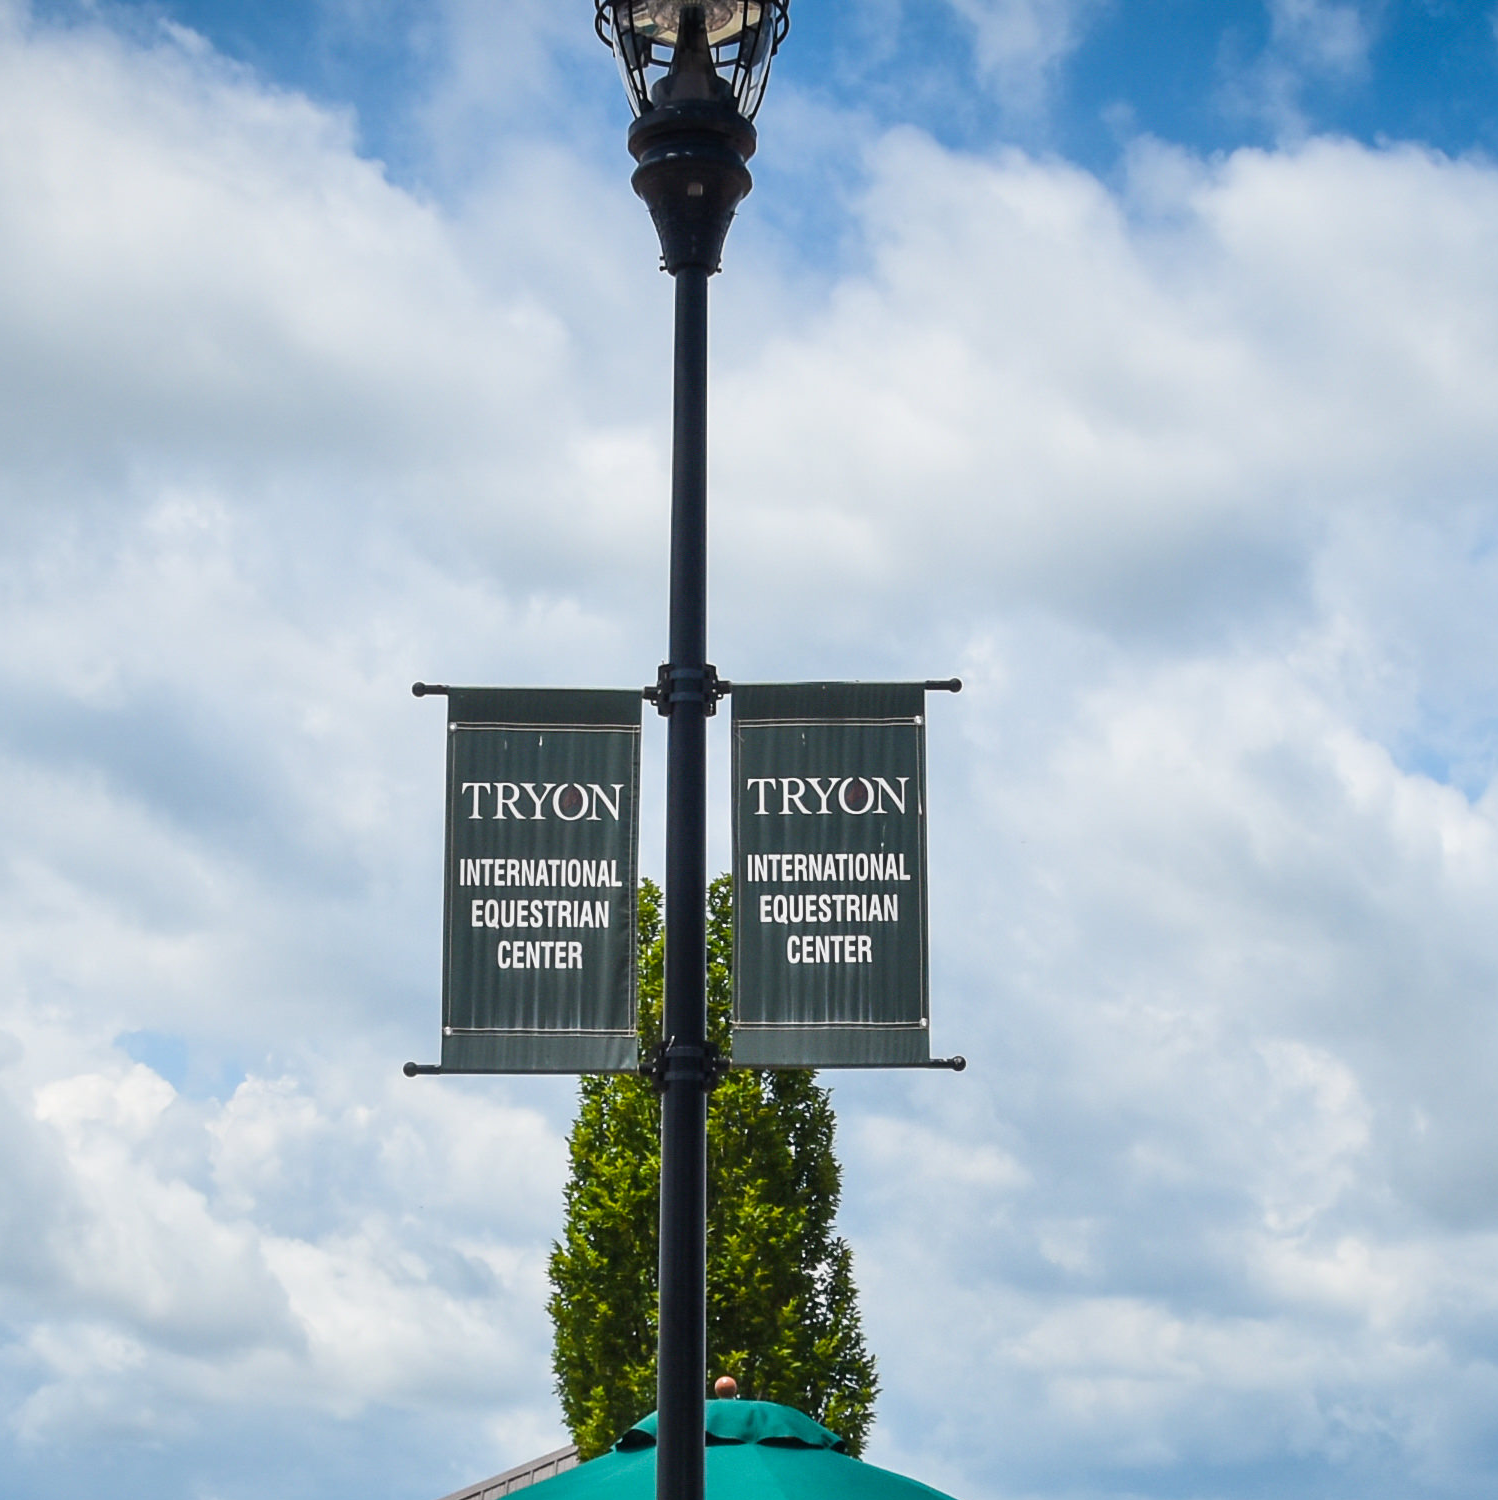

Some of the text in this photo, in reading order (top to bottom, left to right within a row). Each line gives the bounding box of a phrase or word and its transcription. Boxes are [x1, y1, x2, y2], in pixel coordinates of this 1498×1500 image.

[462, 782, 625, 821] TRYON
[747, 777, 909, 815] TRYON
[460, 859, 622, 887] INTERNATIONAL
[747, 853, 911, 882] INTERNATIONAL
[471, 899, 609, 930] EQUESTRIAN
[760, 894, 898, 925] EQUESTRIAN
[498, 940, 582, 969] CENTER
[787, 935, 872, 964] CENTER
